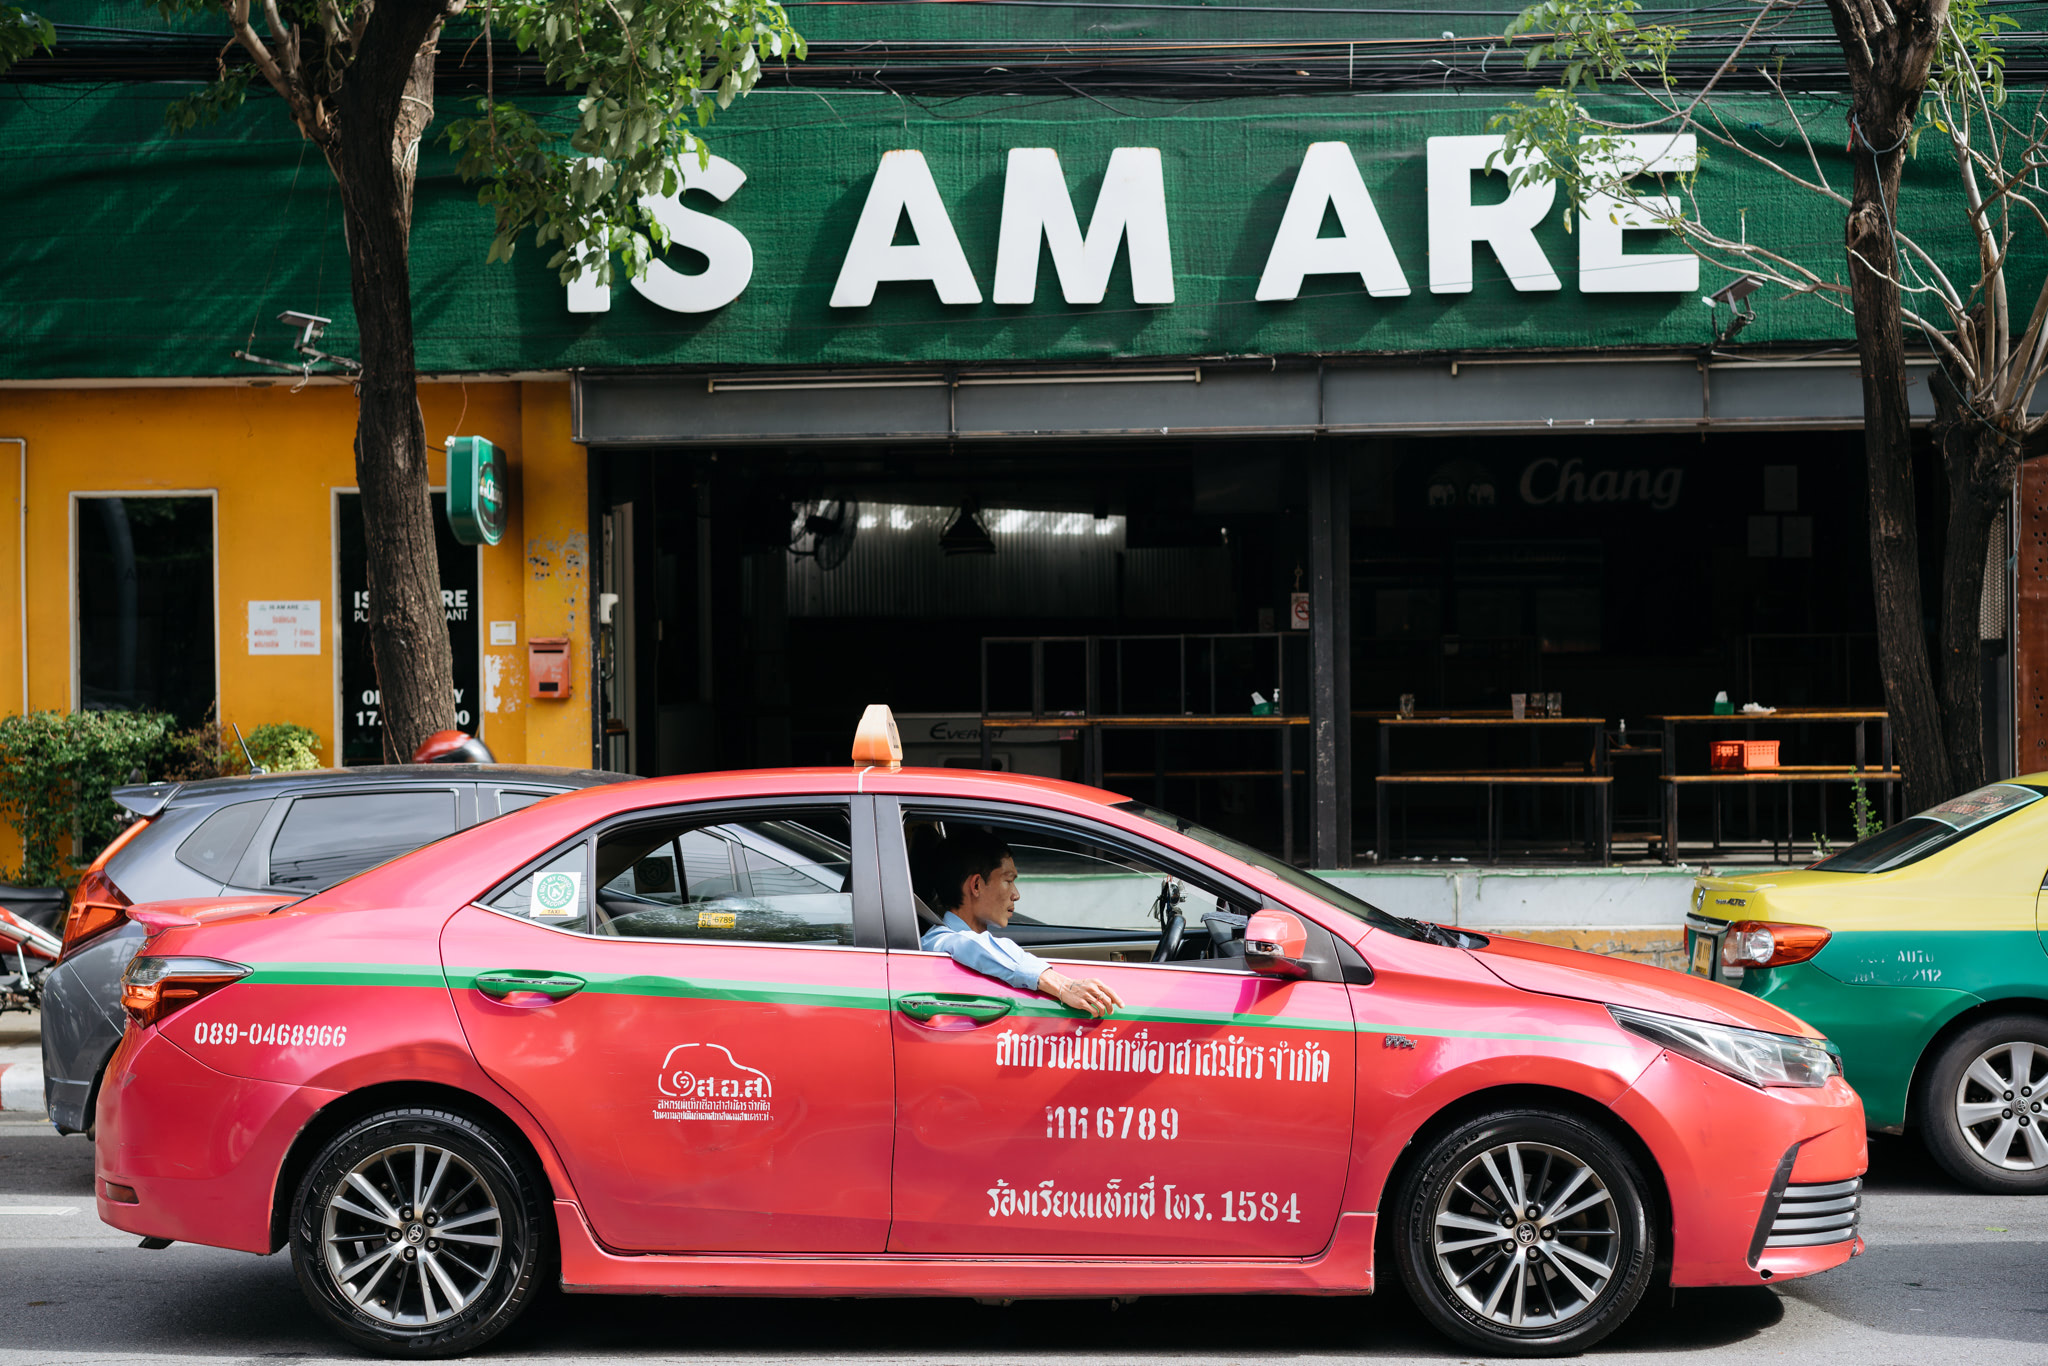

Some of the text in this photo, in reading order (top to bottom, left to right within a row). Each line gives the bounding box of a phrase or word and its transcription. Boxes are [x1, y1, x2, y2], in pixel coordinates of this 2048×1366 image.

[829, 147, 1175, 307] AM
[1255, 134, 1699, 301] ARE
[1519, 457, 1683, 510] Chang
[441, 589, 468, 607] RE
[194, 1022, 347, 1047] 089-0468966
[1097, 1106, 1178, 1140] 6789
[986, 1175, 1301, 1223] ร้องเรียนแท็กซี่ โทร. 1584
